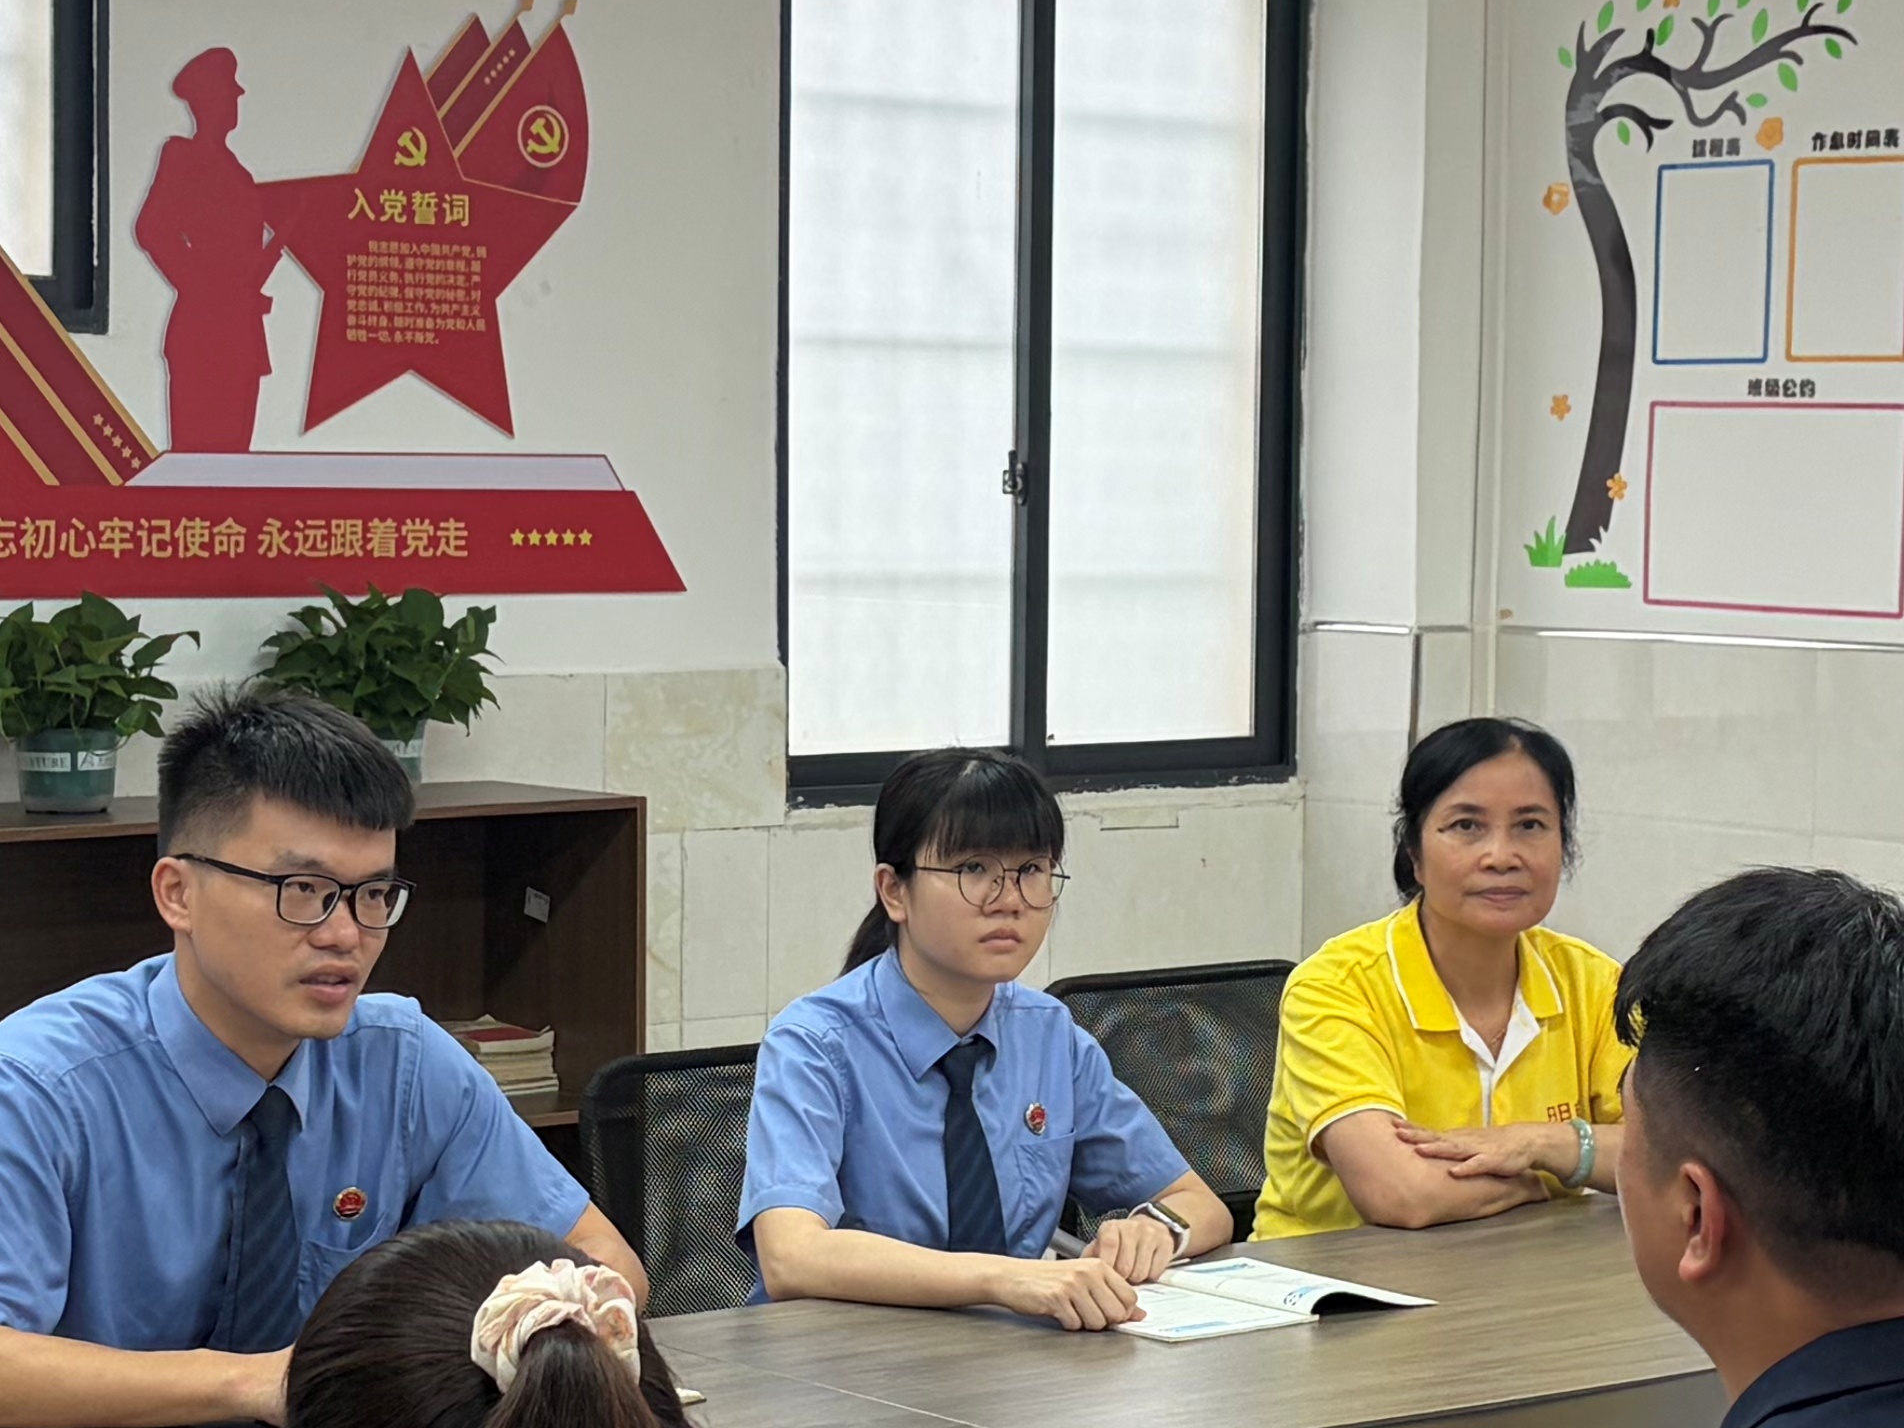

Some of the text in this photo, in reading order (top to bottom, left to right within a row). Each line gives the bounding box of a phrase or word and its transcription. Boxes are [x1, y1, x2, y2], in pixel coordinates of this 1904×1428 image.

[1810, 127, 1901, 152] 作息时间表
[347, 187, 470, 227] 入党誓词
[1747, 378, 1817, 399] 班级公约
[257, 517, 470, 560] 永远跟着党走
